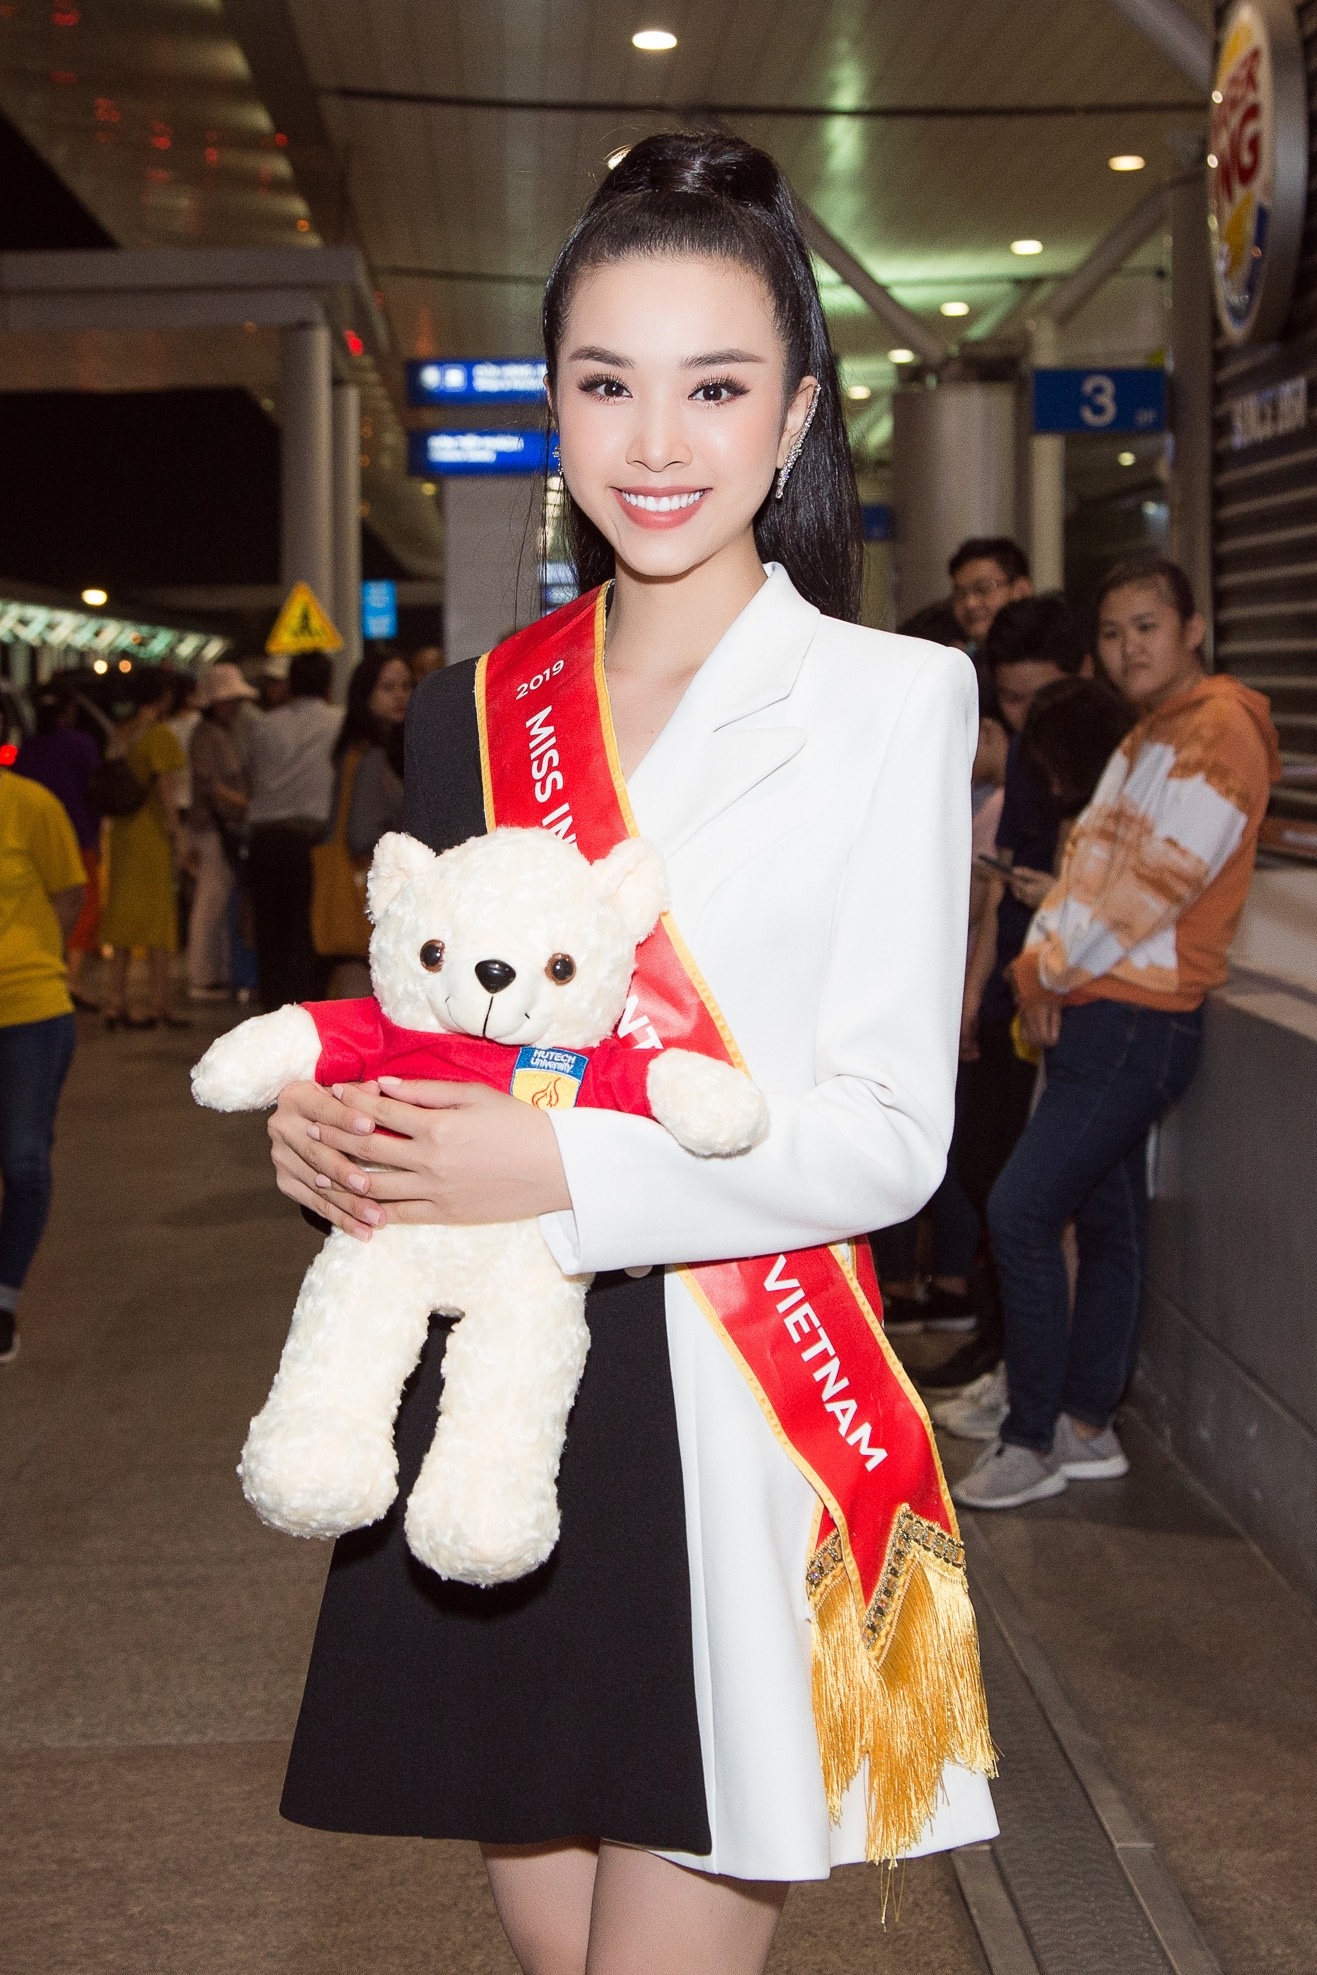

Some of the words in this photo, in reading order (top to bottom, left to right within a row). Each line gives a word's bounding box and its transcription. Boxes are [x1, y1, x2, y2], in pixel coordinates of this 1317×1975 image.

[1081, 375, 1117, 427] 3
[516, 660, 564, 700] 2019
[526, 705, 564, 803] MISS
[533, 1049, 577, 1064] HUTECH
[763, 1254, 888, 1472] VIETNAM
